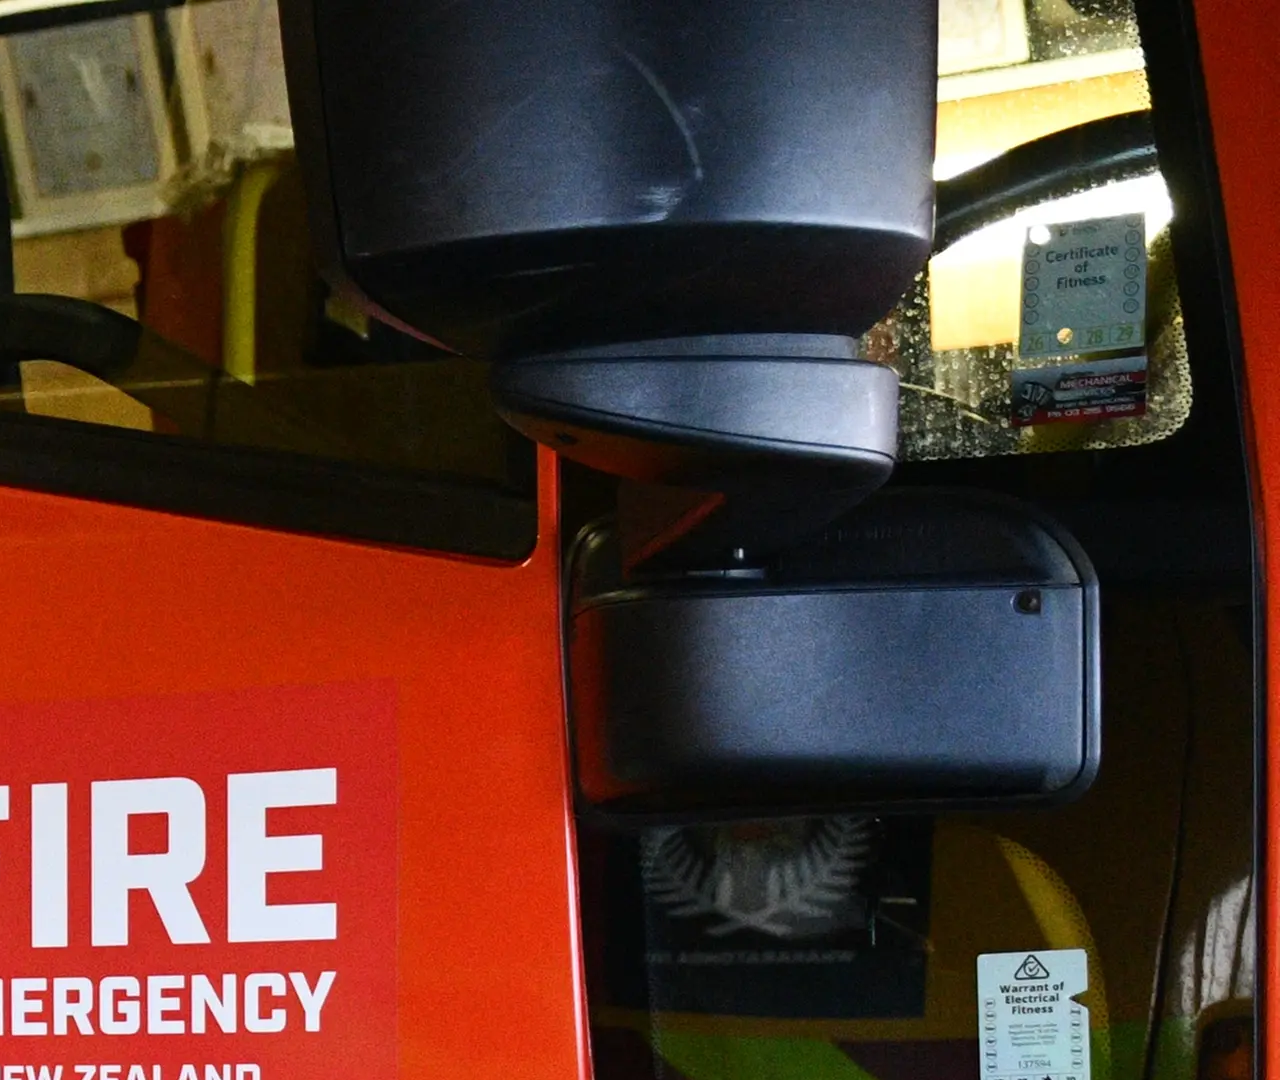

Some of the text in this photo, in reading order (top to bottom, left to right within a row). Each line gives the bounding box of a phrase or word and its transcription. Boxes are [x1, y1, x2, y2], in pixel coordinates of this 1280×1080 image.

[1045, 245, 1119, 263] Certificate
[1074, 261, 1090, 273] of
[1056, 275, 1107, 290] Fitness
[1060, 374, 1133, 390] MECHANICAL
[999, 981, 1065, 994] Warrant of
[1005, 993, 1060, 1005] Electrical
[1011, 1005, 1054, 1015] Fitness
